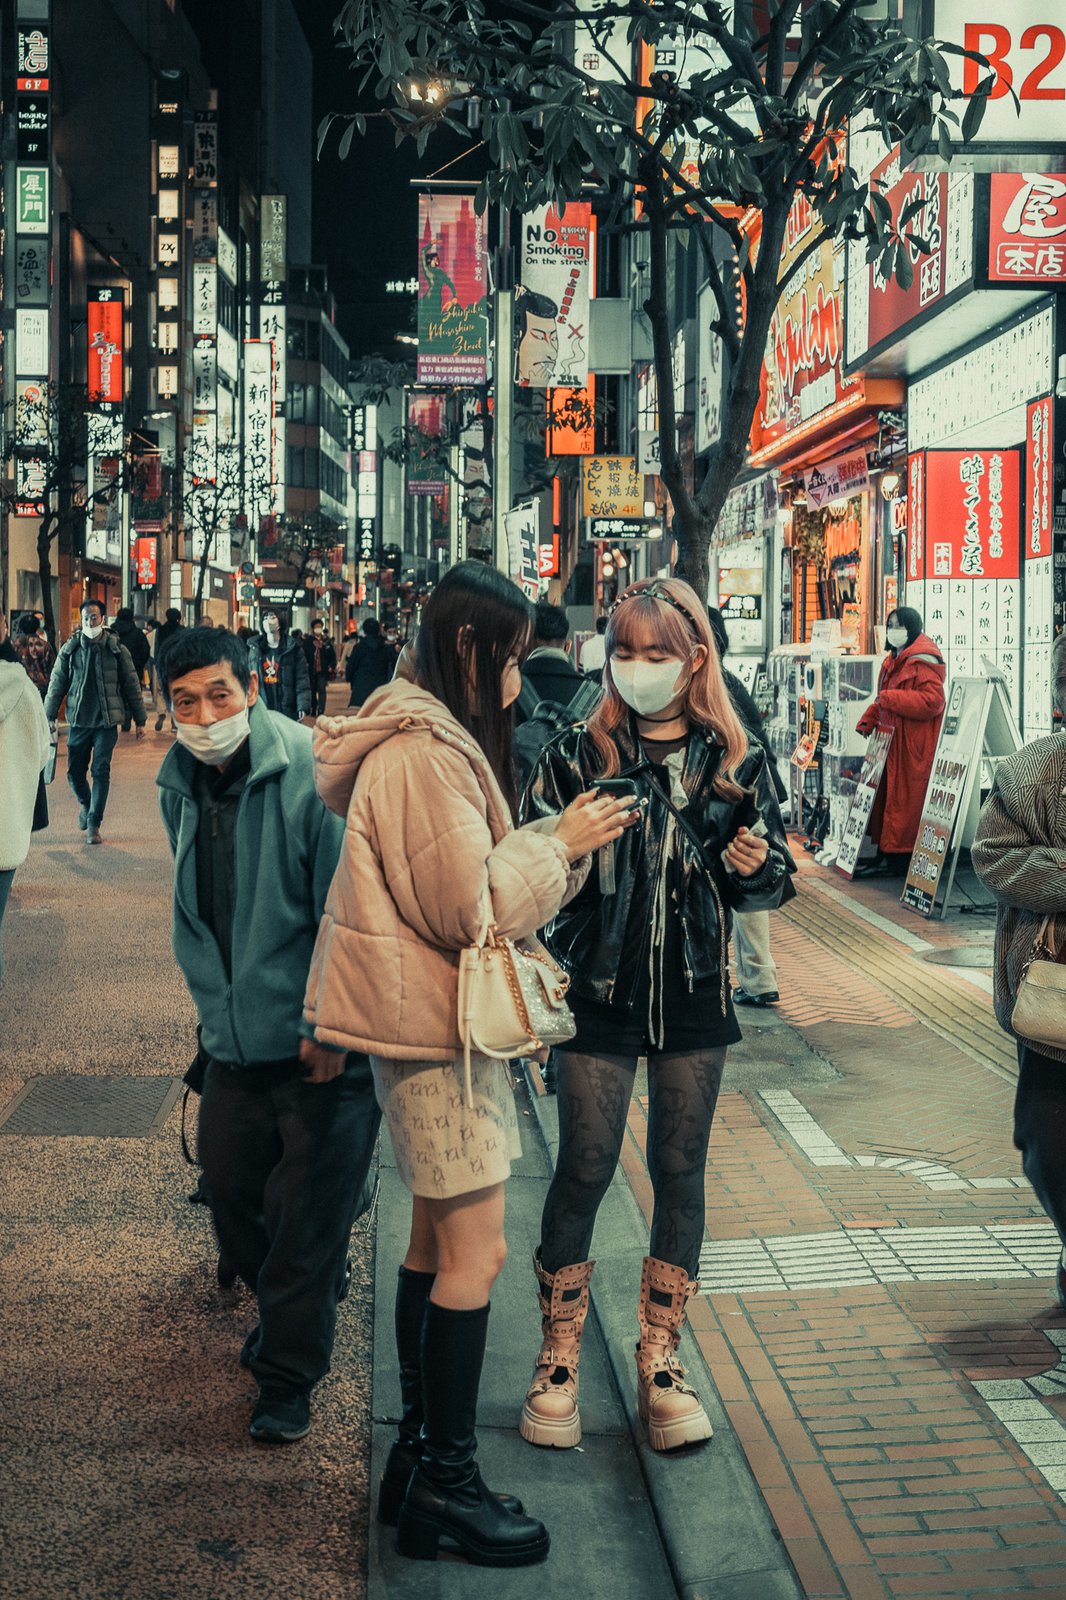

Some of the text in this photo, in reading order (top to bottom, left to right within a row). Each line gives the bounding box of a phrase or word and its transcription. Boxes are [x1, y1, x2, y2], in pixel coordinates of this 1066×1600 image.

[25, 31, 48, 73] HUB
[657, 53, 674, 64] 2F
[963, 23, 1066, 101] B2
[527, 225, 557, 242] No
[527, 243, 584, 258] Smoking
[526, 257, 538, 265] On
[542, 258, 556, 266] the
[1005, 247, 1065, 275] 本店
[267, 281, 279, 290] 4F
[98, 290, 112, 301] 2F
[264, 292, 282, 303] 4F
[622, 505, 637, 514] 4F
[361, 519, 373, 559] ZARA
[933, 757, 966, 790] HAPPY
[926, 787, 955, 820] HOUR
